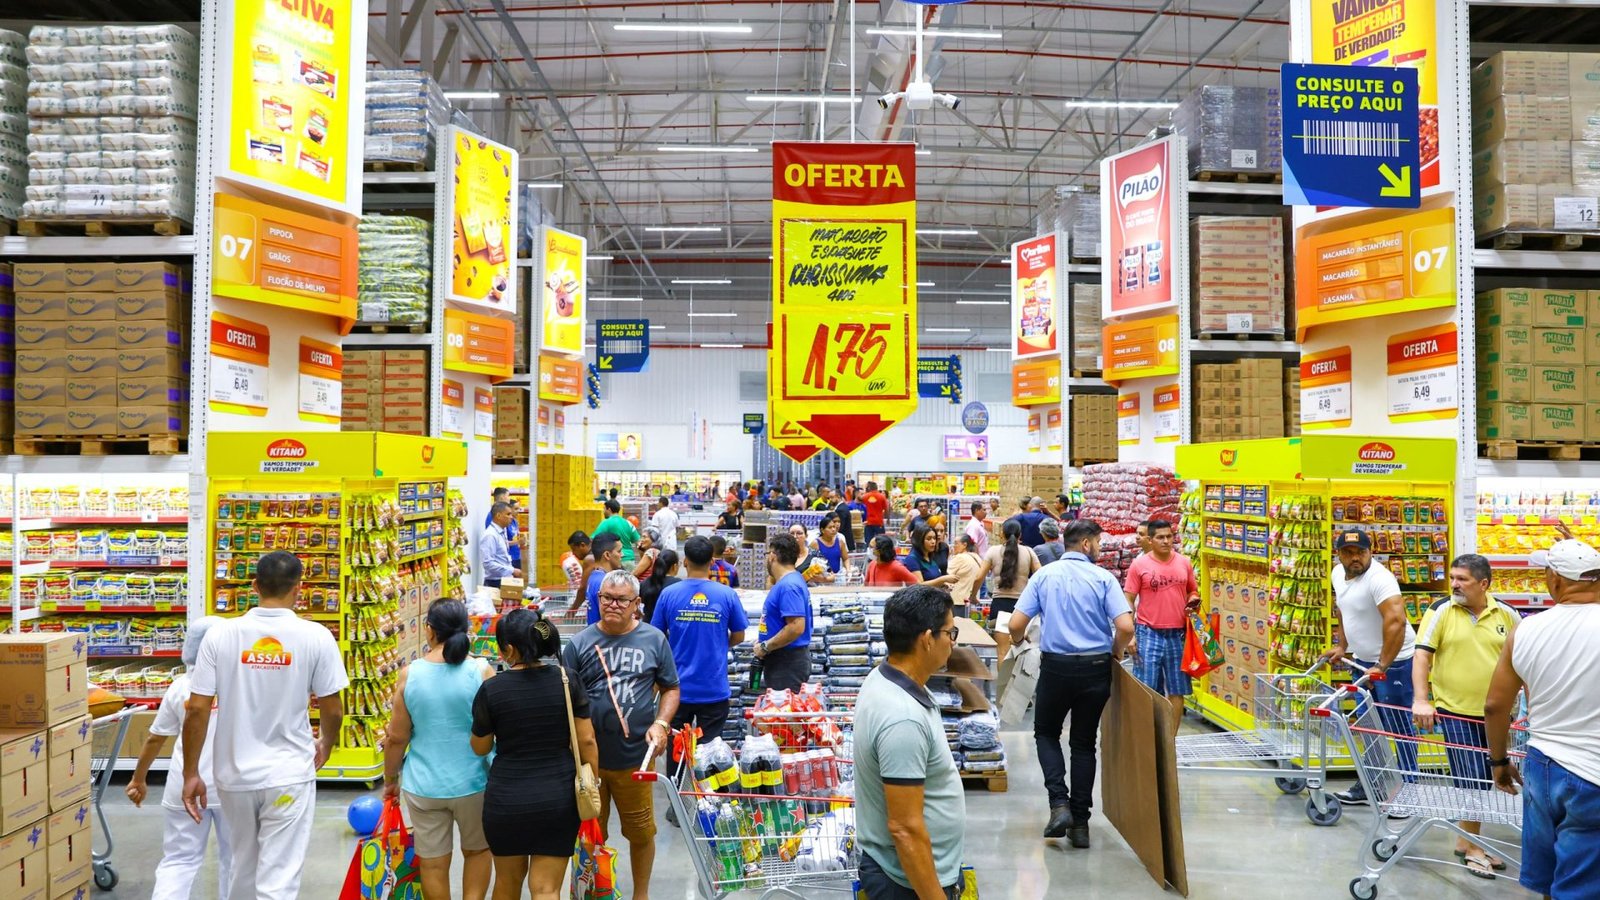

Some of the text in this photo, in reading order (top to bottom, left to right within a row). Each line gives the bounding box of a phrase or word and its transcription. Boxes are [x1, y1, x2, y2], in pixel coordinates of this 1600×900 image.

[1336, 4, 1402, 45] TEMPERAR
[1334, 22, 1405, 62] DE VERDADE?
[1296, 77, 1404, 94] CONSULTE O
[1297, 94, 1402, 113] PREÇO AQUI
[1245, 156, 1254, 164] 06
[784, 163, 905, 188] OFERTA
[1122, 175, 1159, 200] PILÃO
[1580, 209, 1593, 222] 12
[269, 228, 294, 240] PIPOCA
[220, 234, 253, 261] 07
[810, 244, 883, 261] ESPAGUETE
[1322, 238, 1400, 260] MACARRÃO INSTANTÂNEO
[268, 250, 292, 264] GRÃOS
[1414, 246, 1449, 273] 07
[1322, 268, 1360, 282] MACARRÃO
[268, 276, 326, 293] FLOCÃO DE MILHO
[1324, 293, 1354, 305] LASANHA
[1241, 320, 1250, 328] 09
[226, 329, 256, 348] OFERTA
[447, 332, 464, 348] 08
[602, 330, 624, 338] PREÇO
[1159, 338, 1176, 352] 08
[1403, 340, 1438, 358] OFERTA
[311, 351, 333, 366] OFERTA
[1311, 360, 1338, 375] OFERTA
[235, 378, 248, 392] 6,49
[1048, 376, 1059, 388] 09
[1414, 385, 1430, 400] 6,49
[1319, 398, 1330, 410] 6,49
[270, 447, 304, 456] KITANO
[1361, 450, 1394, 459] KITANO
[247, 652, 286, 664] ASSAÍ
